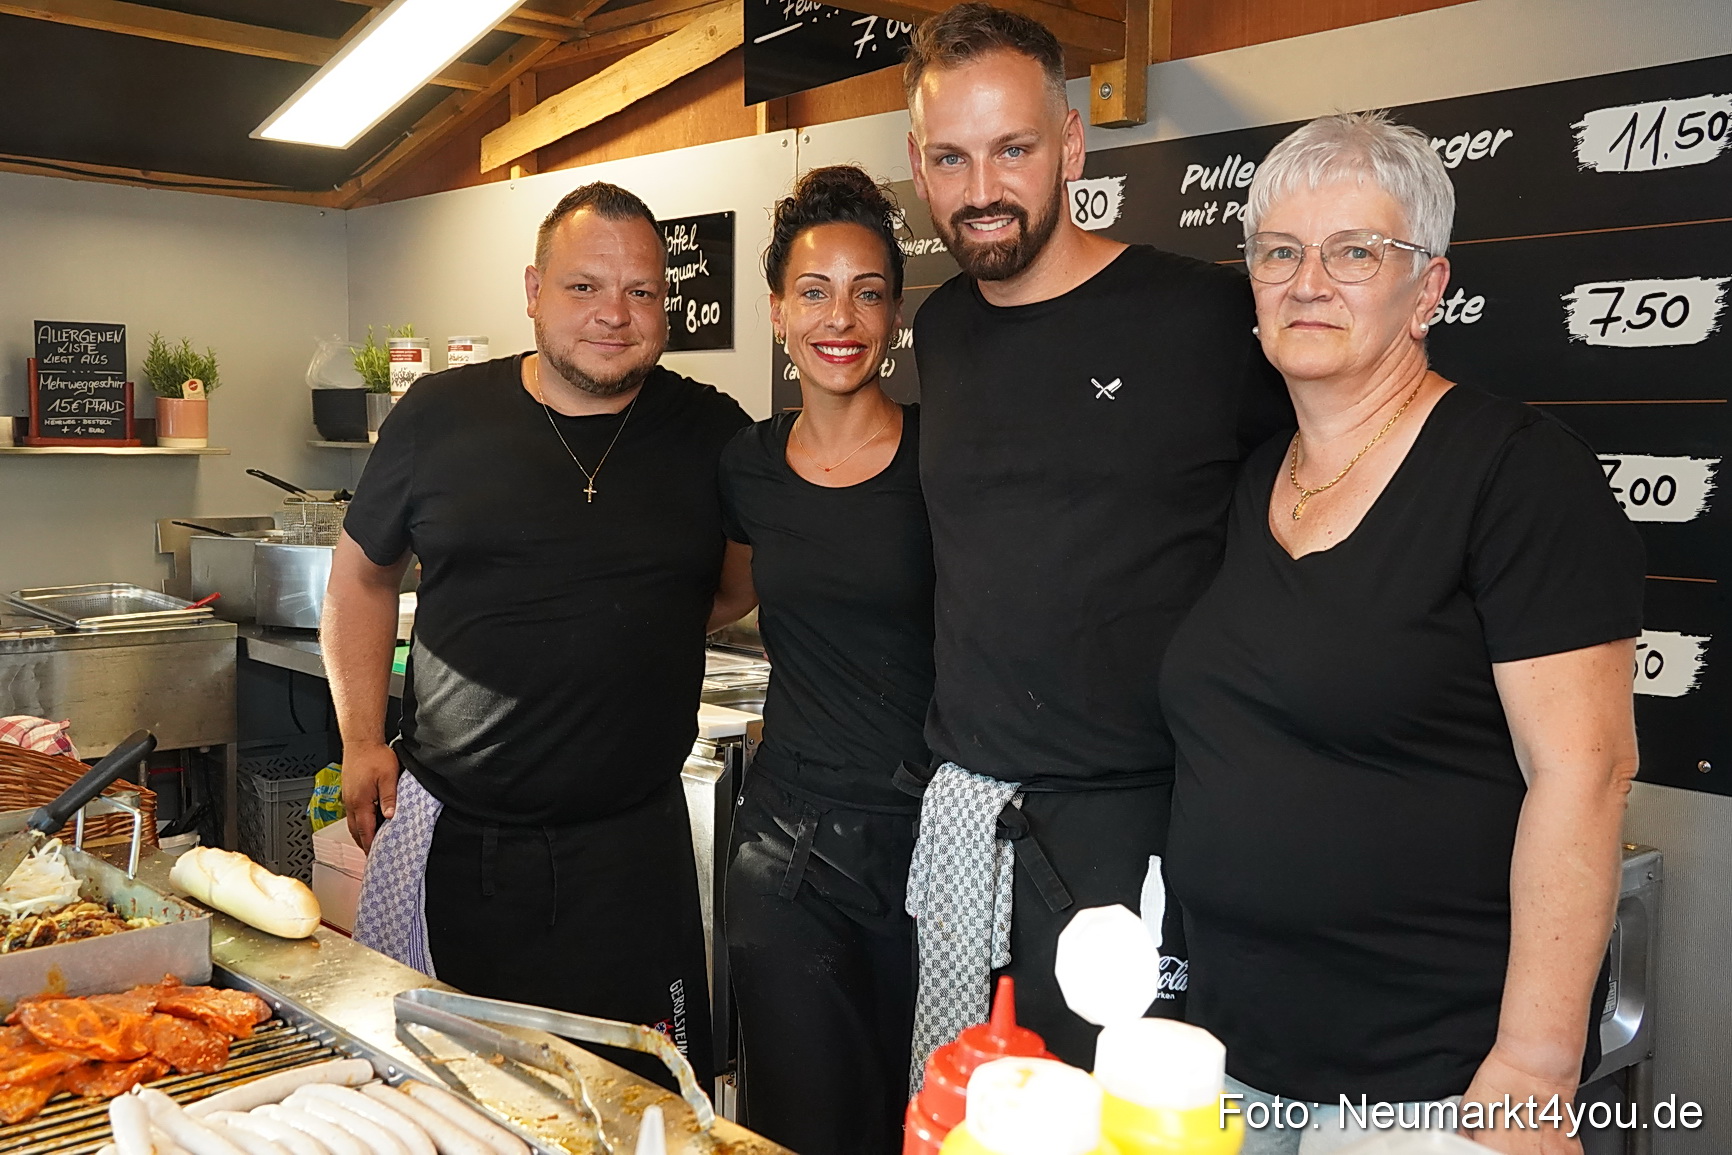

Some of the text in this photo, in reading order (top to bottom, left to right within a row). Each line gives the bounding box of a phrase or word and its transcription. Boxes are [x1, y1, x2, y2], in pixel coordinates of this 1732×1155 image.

[1609, 106, 1729, 170] 11.50
[1074, 188, 1108, 224] 80
[1179, 201, 1219, 228] mit
[665, 250, 709, 294] rquark
[686, 299, 720, 333] 8.00
[38, 325, 124, 345] ALLERGENEN
[58, 342, 99, 354] LISTE
[43, 353, 108, 365] LIEGT AUS
[47, 398, 80, 413] 15€
